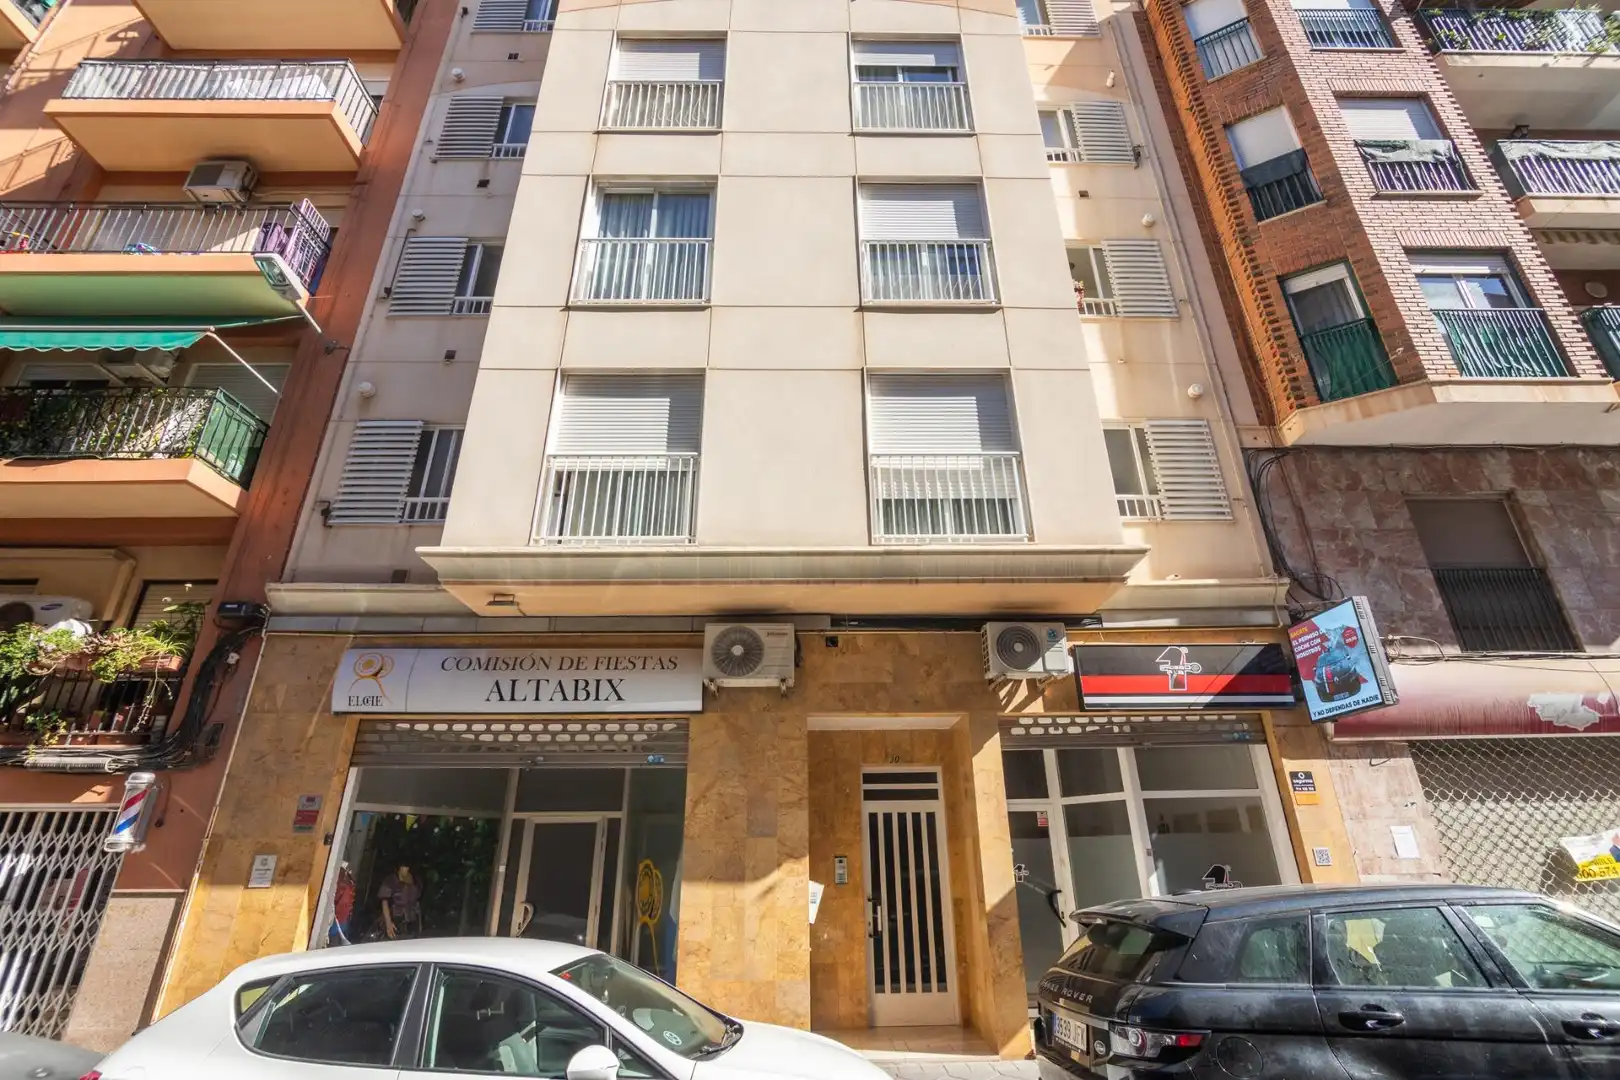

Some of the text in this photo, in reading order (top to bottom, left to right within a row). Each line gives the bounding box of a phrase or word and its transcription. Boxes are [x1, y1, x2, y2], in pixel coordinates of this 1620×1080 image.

[1294, 638, 1321, 652] COCHE CON
[1299, 631, 1319, 643] PERMISO
[441, 653, 678, 672] COMISIÓN DE FIESTAS
[485, 678, 626, 702] ALTABIX
[1326, 702, 1352, 713] DEPENDAS
[1361, 694, 1379, 704] NADIE
[1061, 988, 1094, 1004] ROVER
